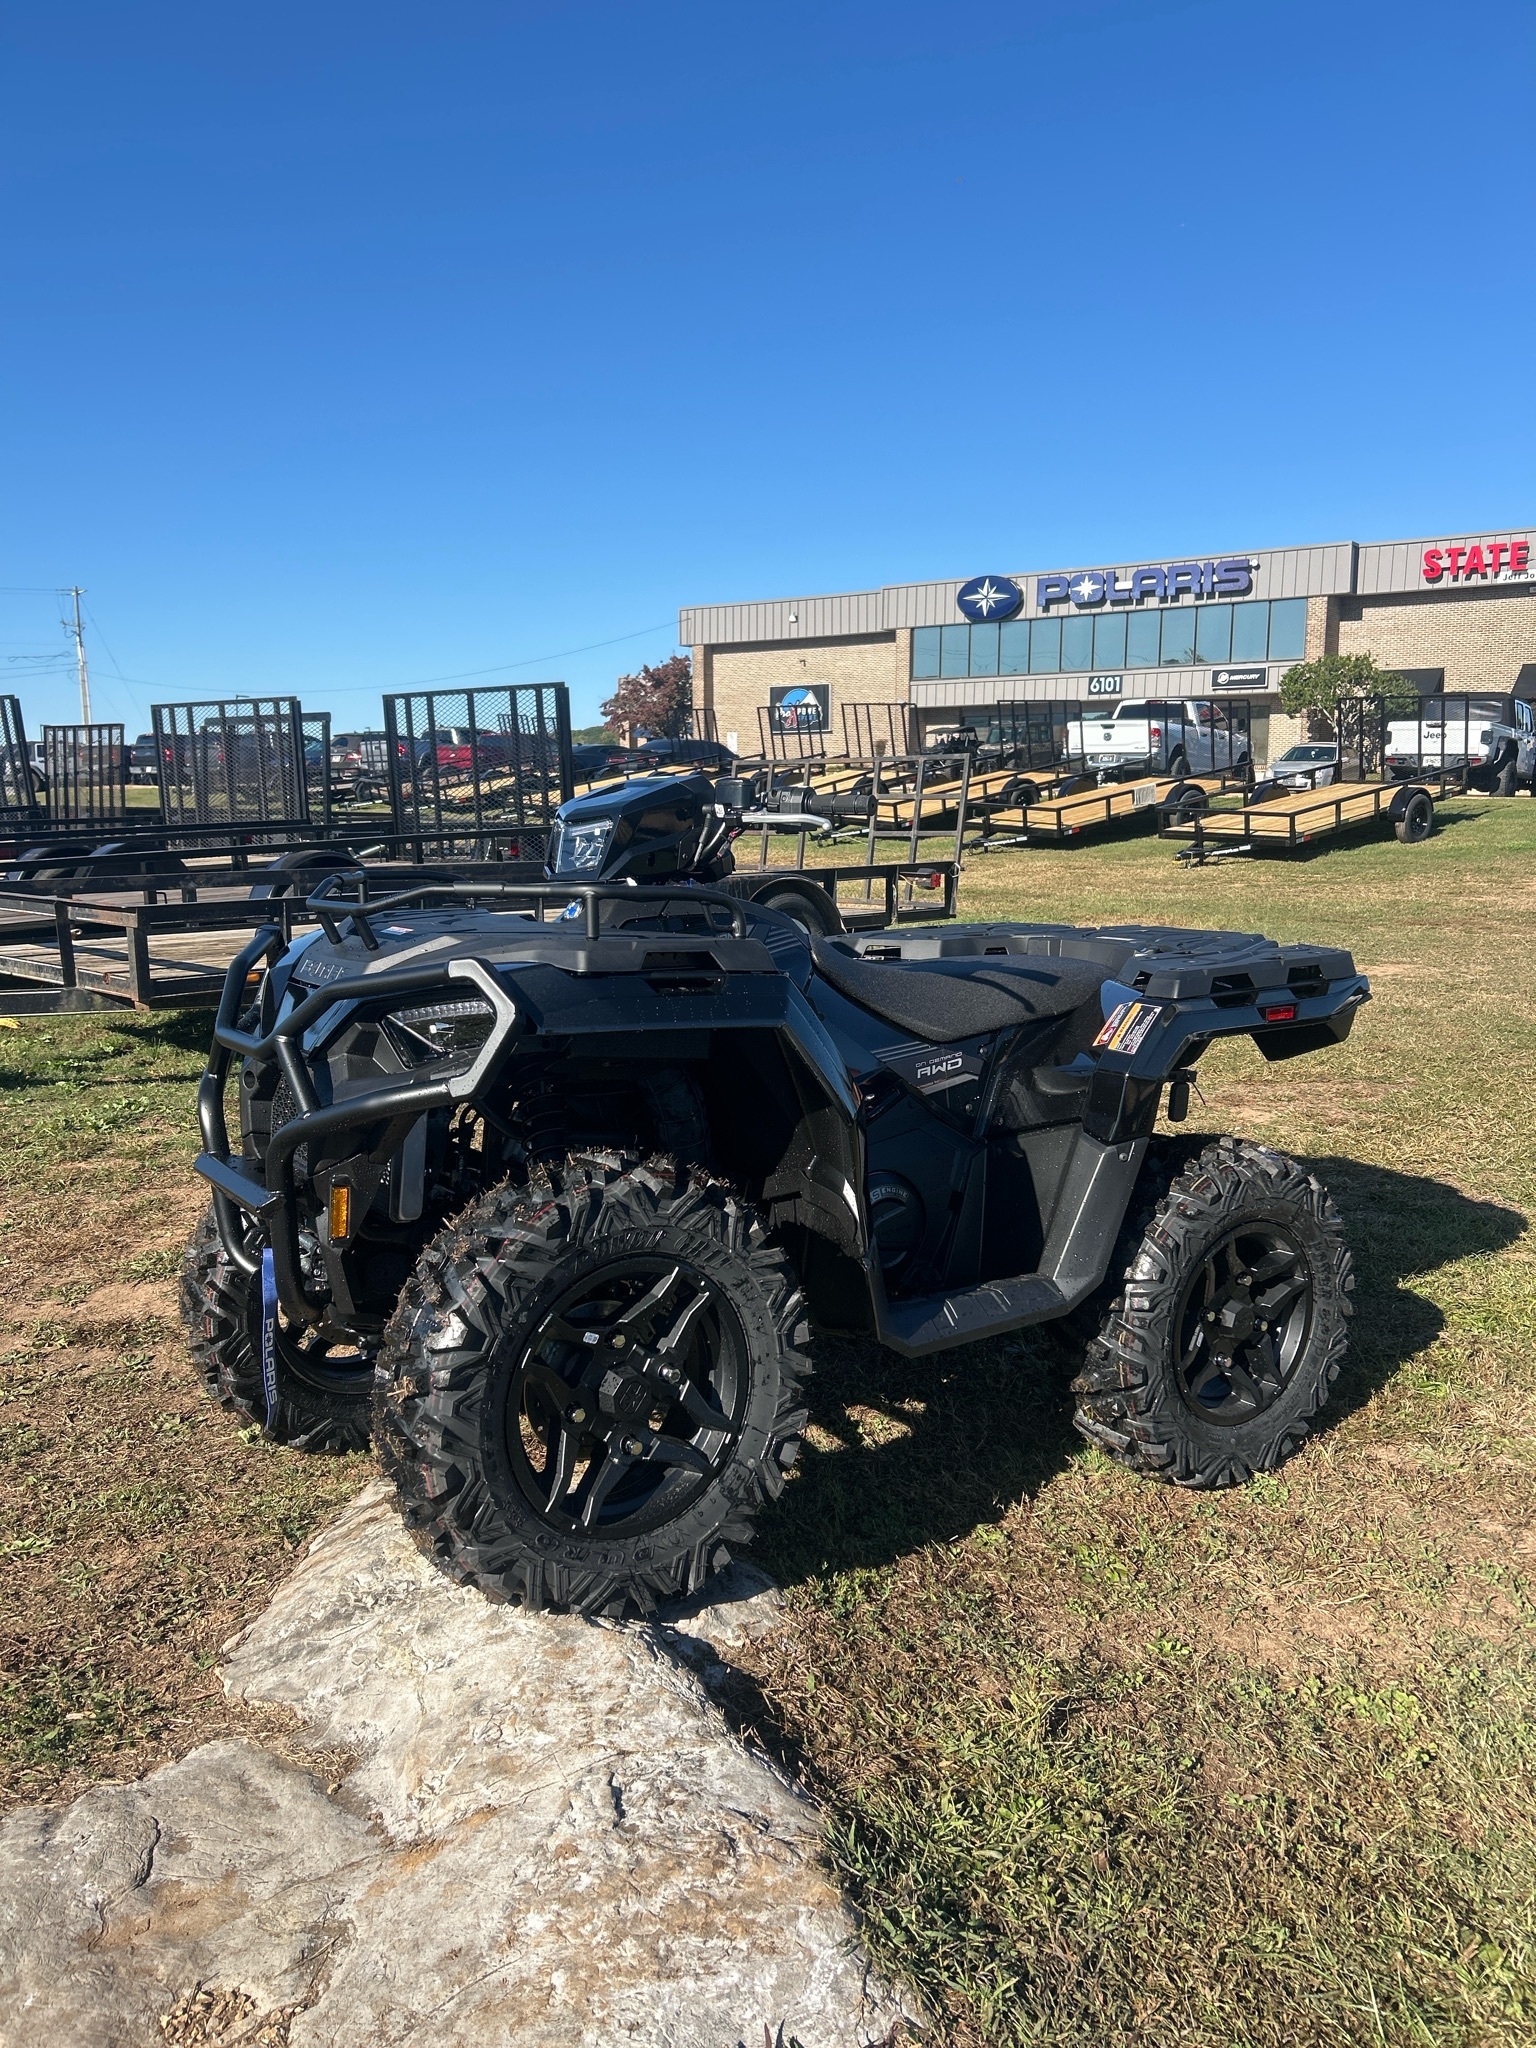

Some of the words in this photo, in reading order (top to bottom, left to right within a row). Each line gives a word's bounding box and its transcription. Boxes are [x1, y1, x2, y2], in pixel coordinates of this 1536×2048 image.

[1422, 541, 1529, 578] STATE
[1036, 559, 1250, 608] POLARIS
[1089, 676, 1121, 693] 6101
[1229, 673, 1261, 681] MERCURY
[917, 1057, 963, 1079] AWD
[929, 1051, 963, 1065] DEMAND
[264, 1317, 278, 1405] POLARIS
